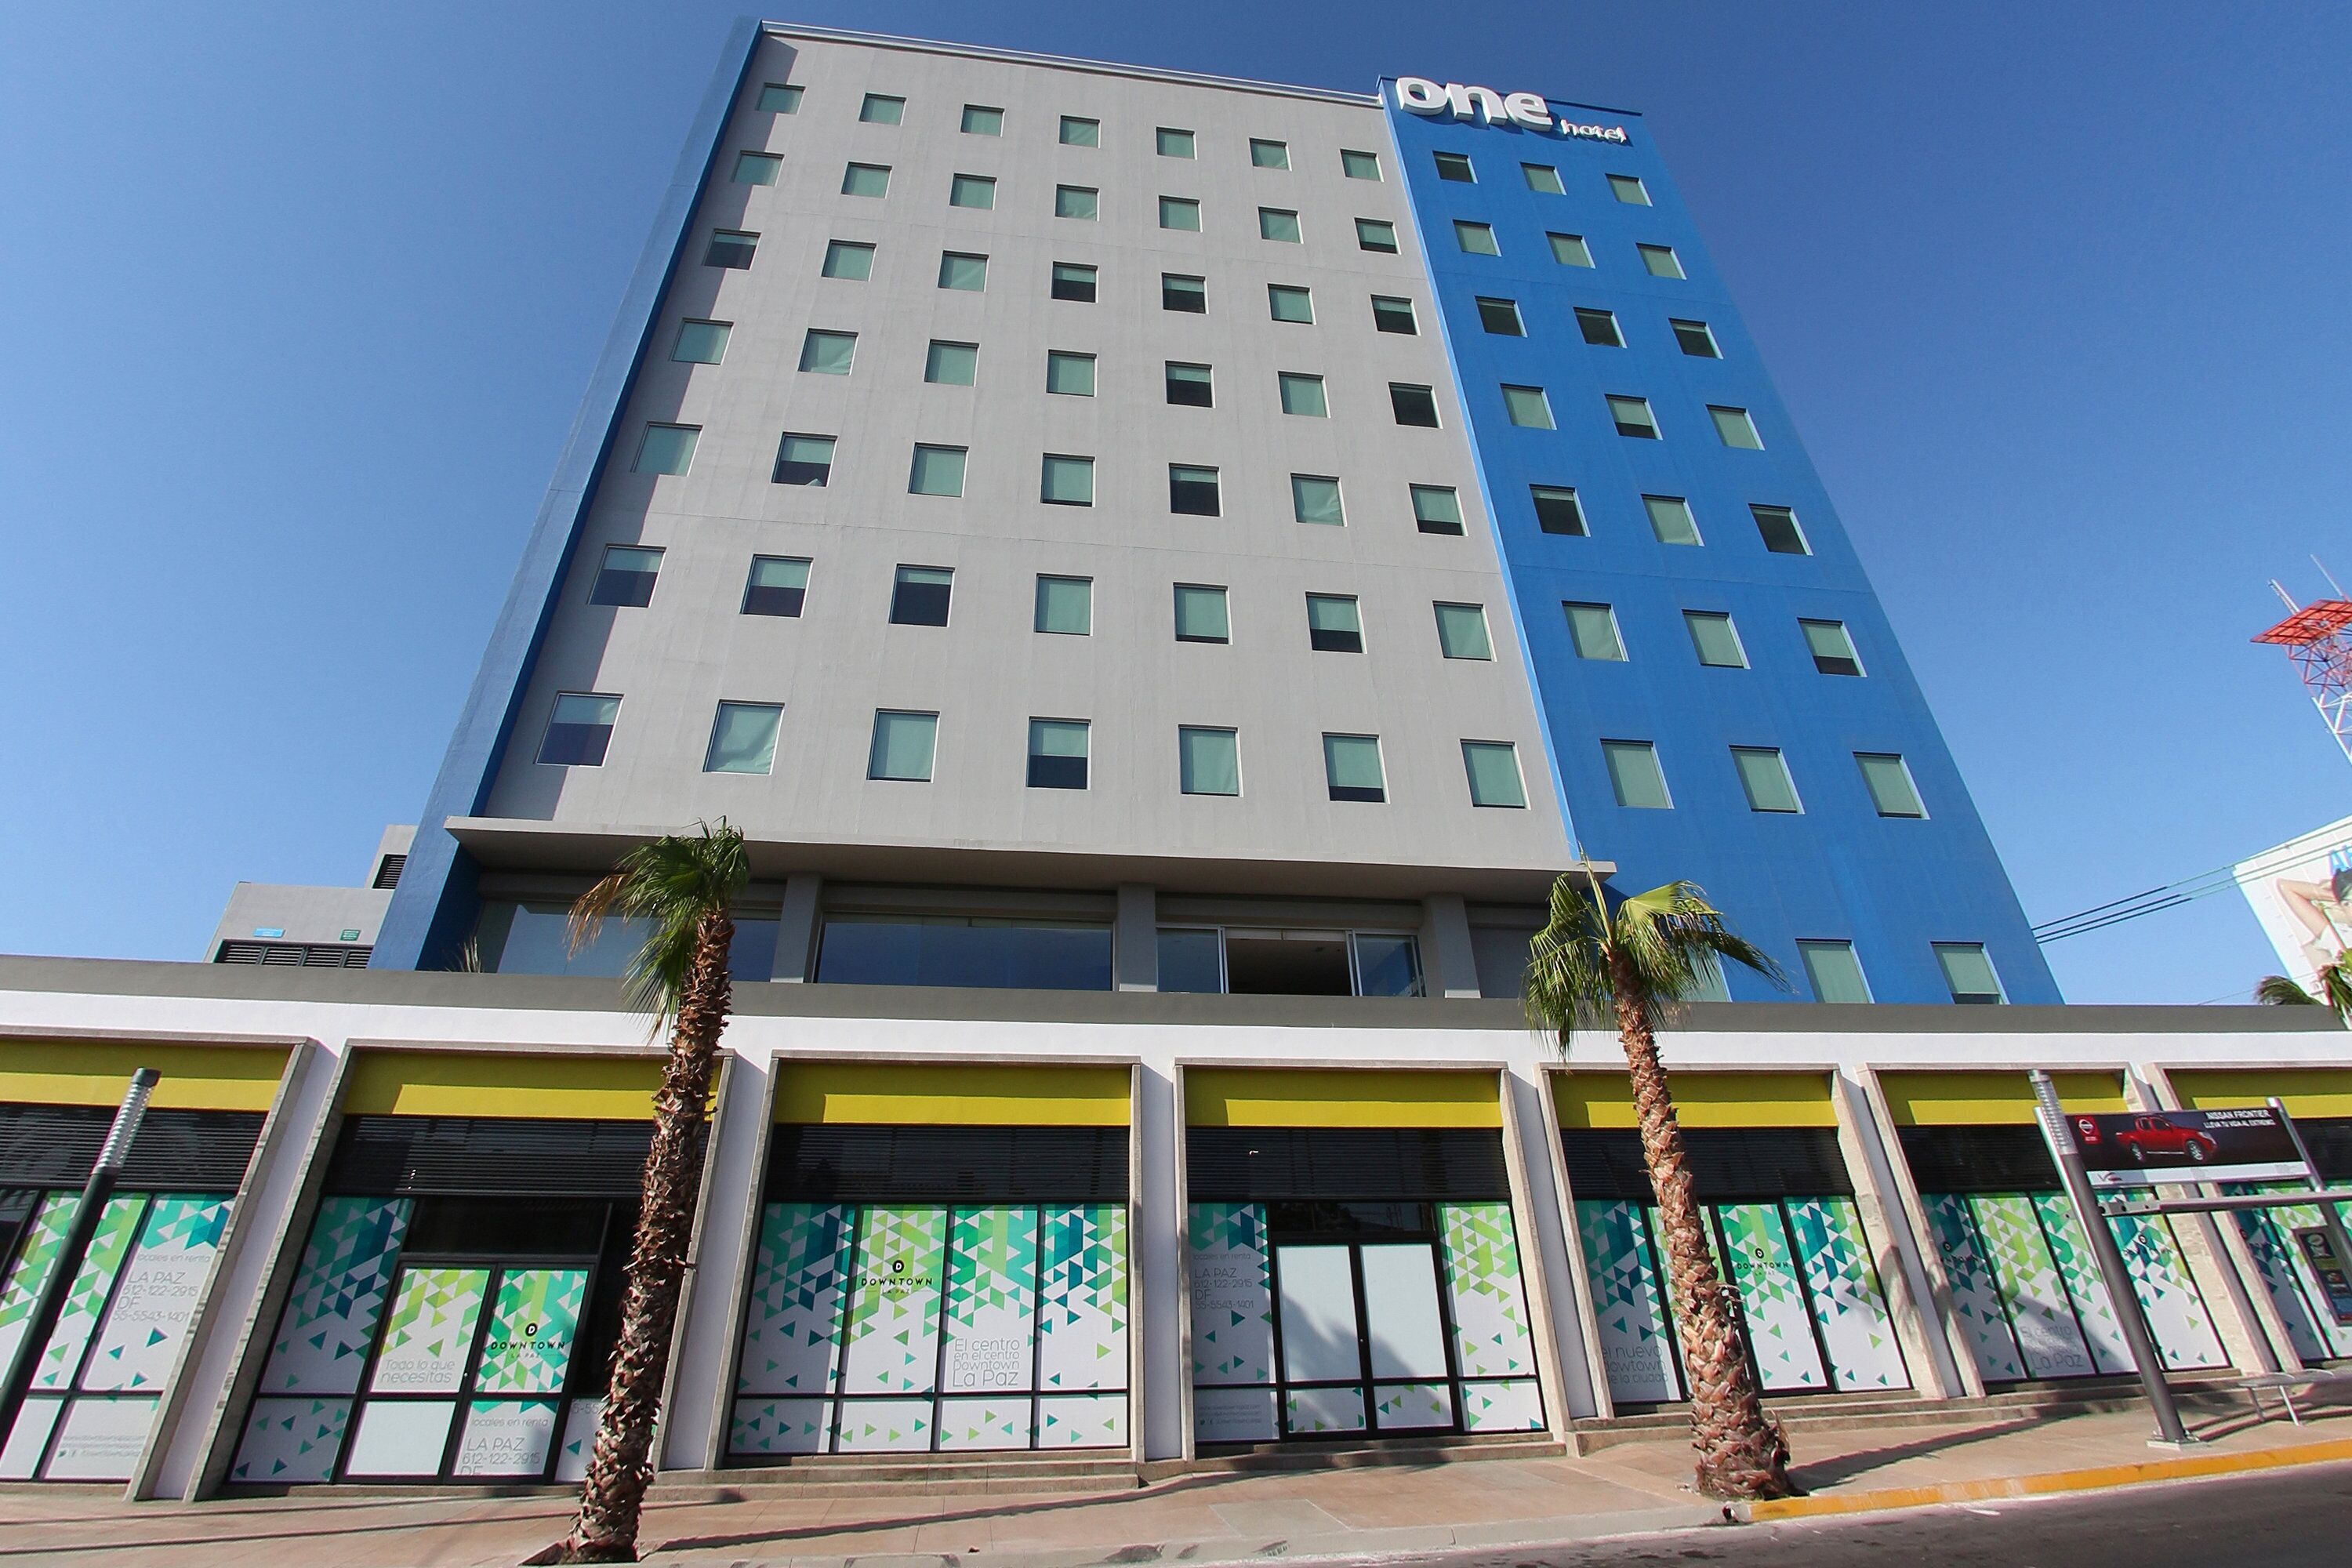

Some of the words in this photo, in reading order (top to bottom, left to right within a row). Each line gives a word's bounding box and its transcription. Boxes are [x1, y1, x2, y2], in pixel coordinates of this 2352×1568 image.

[1396, 77, 1553, 132] one
[1559, 119, 1627, 143] hotel
[128, 1272, 148, 1283] LA
[152, 1271, 186, 1284] PAZ
[1194, 1268, 1210, 1279] LA
[1214, 1267, 1237, 1278] PAZ
[861, 1277, 933, 1287] DOWNTOWN
[1195, 1288, 1211, 1301] DF
[116, 1296, 141, 1310] DF
[490, 1341, 565, 1350] DOWNTOWN
[954, 1338, 967, 1352] El
[971, 1338, 1020, 1352] centro
[953, 1352, 969, 1360] en
[971, 1351, 982, 1360] el
[984, 1351, 1020, 1360] centro
[1615, 1345, 1663, 1359] nuevo
[385, 1359, 414, 1370] Todo
[416, 1359, 429, 1370] lo
[430, 1360, 456, 1373] que
[953, 1359, 1020, 1371] Downtown
[381, 1372, 452, 1384] necesitas
[953, 1370, 975, 1387] La
[982, 1370, 1018, 1387] Paz
[472, 1417, 504, 1427] locales
[522, 1418, 549, 1427] renta
[466, 1438, 488, 1451] LA
[492, 1438, 525, 1451] PAZ
[462, 1452, 541, 1465] 612-122-2915
